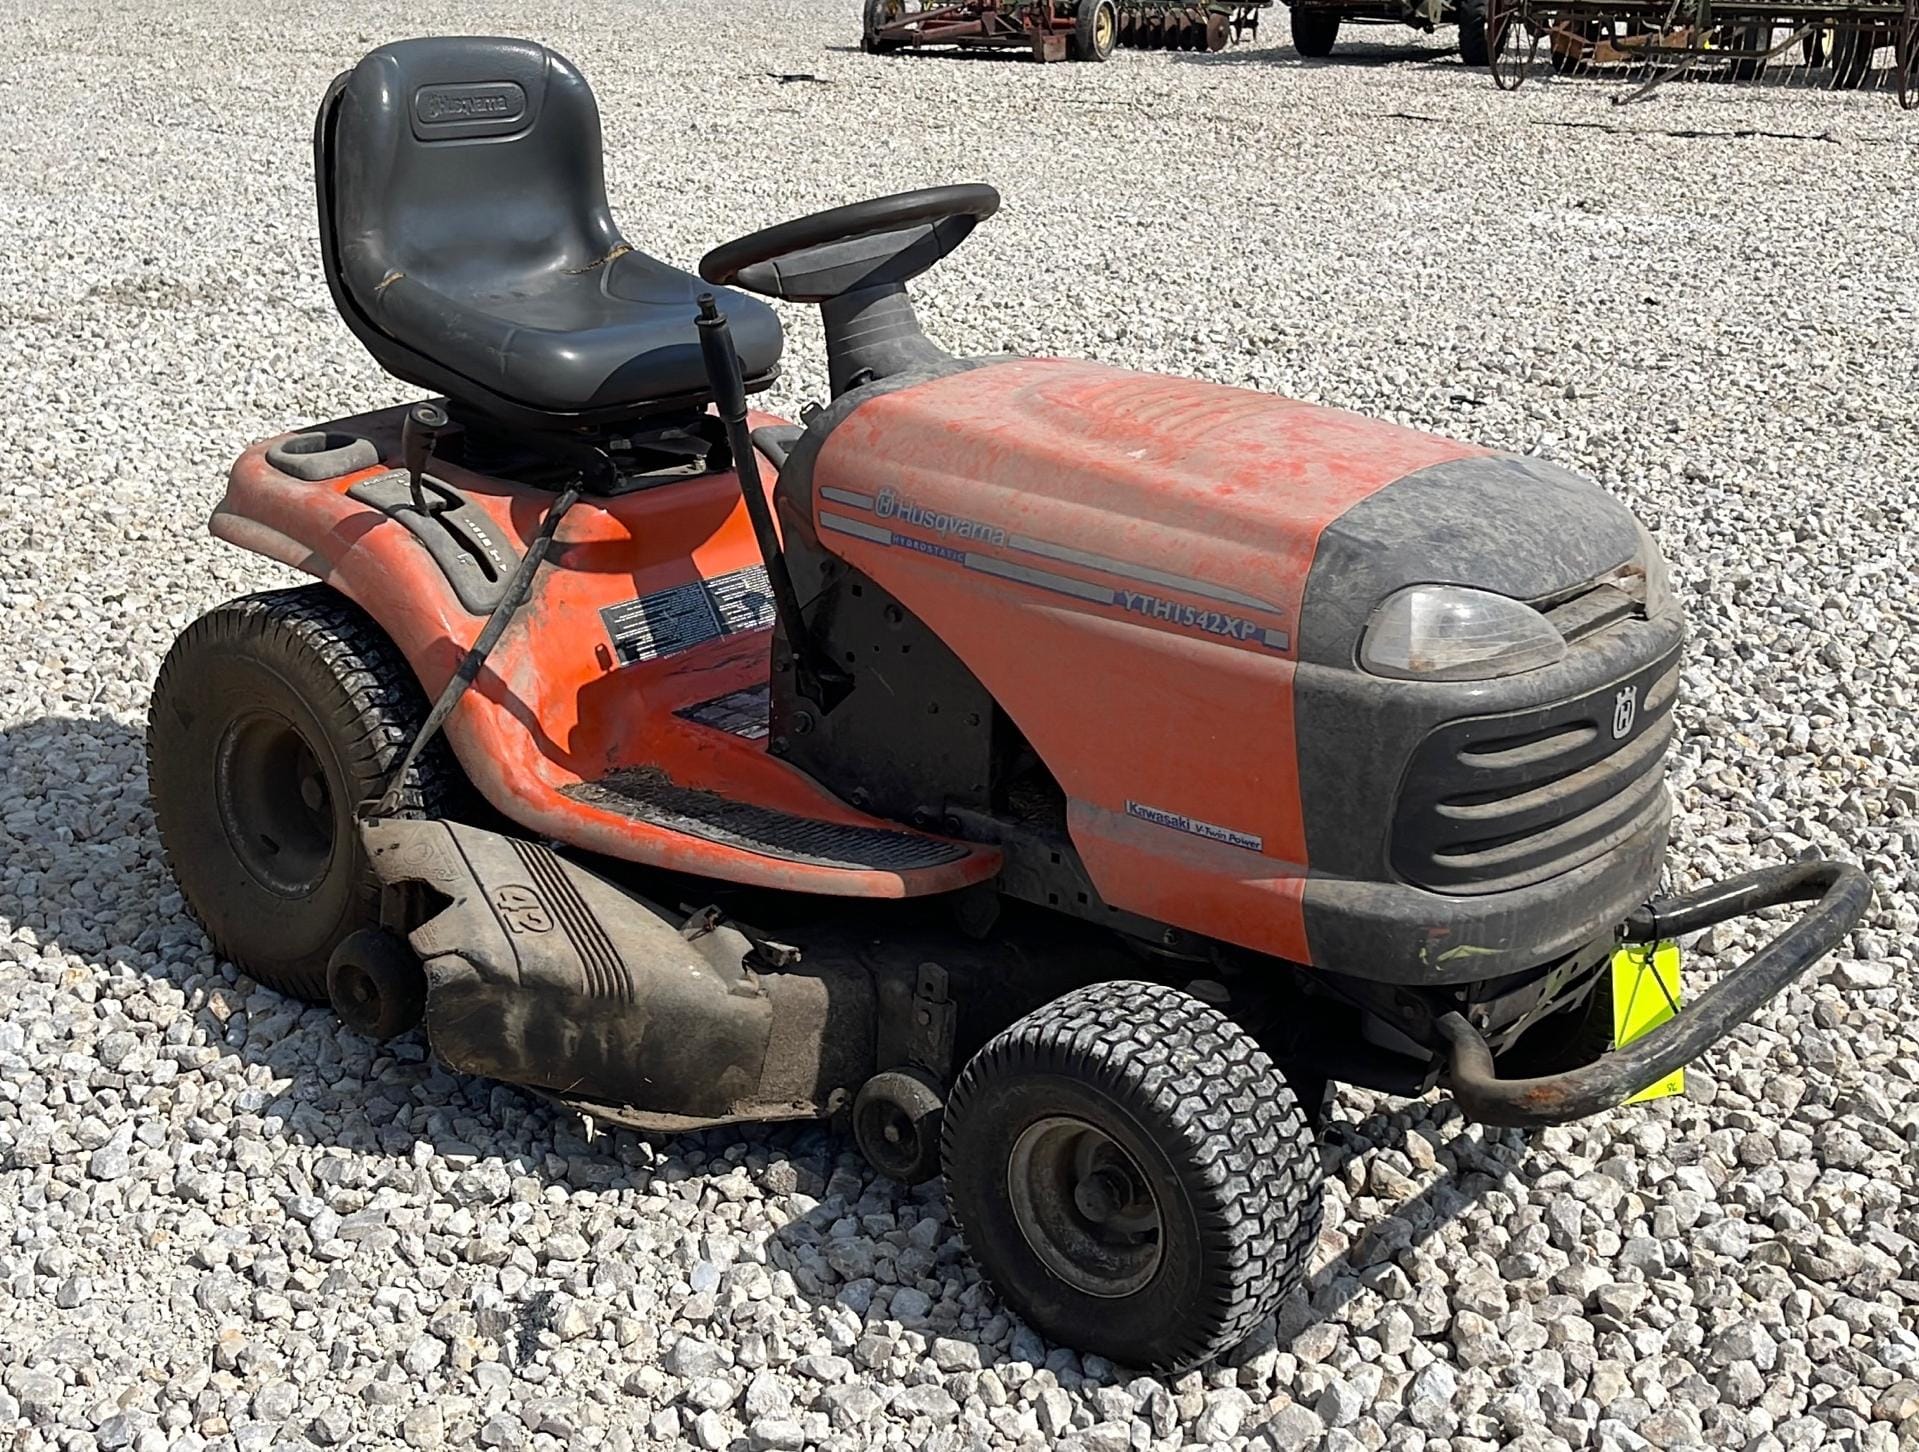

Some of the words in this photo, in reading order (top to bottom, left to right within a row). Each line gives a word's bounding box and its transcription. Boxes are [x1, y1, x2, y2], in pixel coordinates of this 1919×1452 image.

[897, 500, 1006, 546] Husqvarna
[892, 535, 965, 562] HYDROSTATIC
[1124, 591, 1256, 639] YTH1542XP
[1129, 801, 1191, 832] Kawasaki
[1228, 833, 1260, 850] Power
